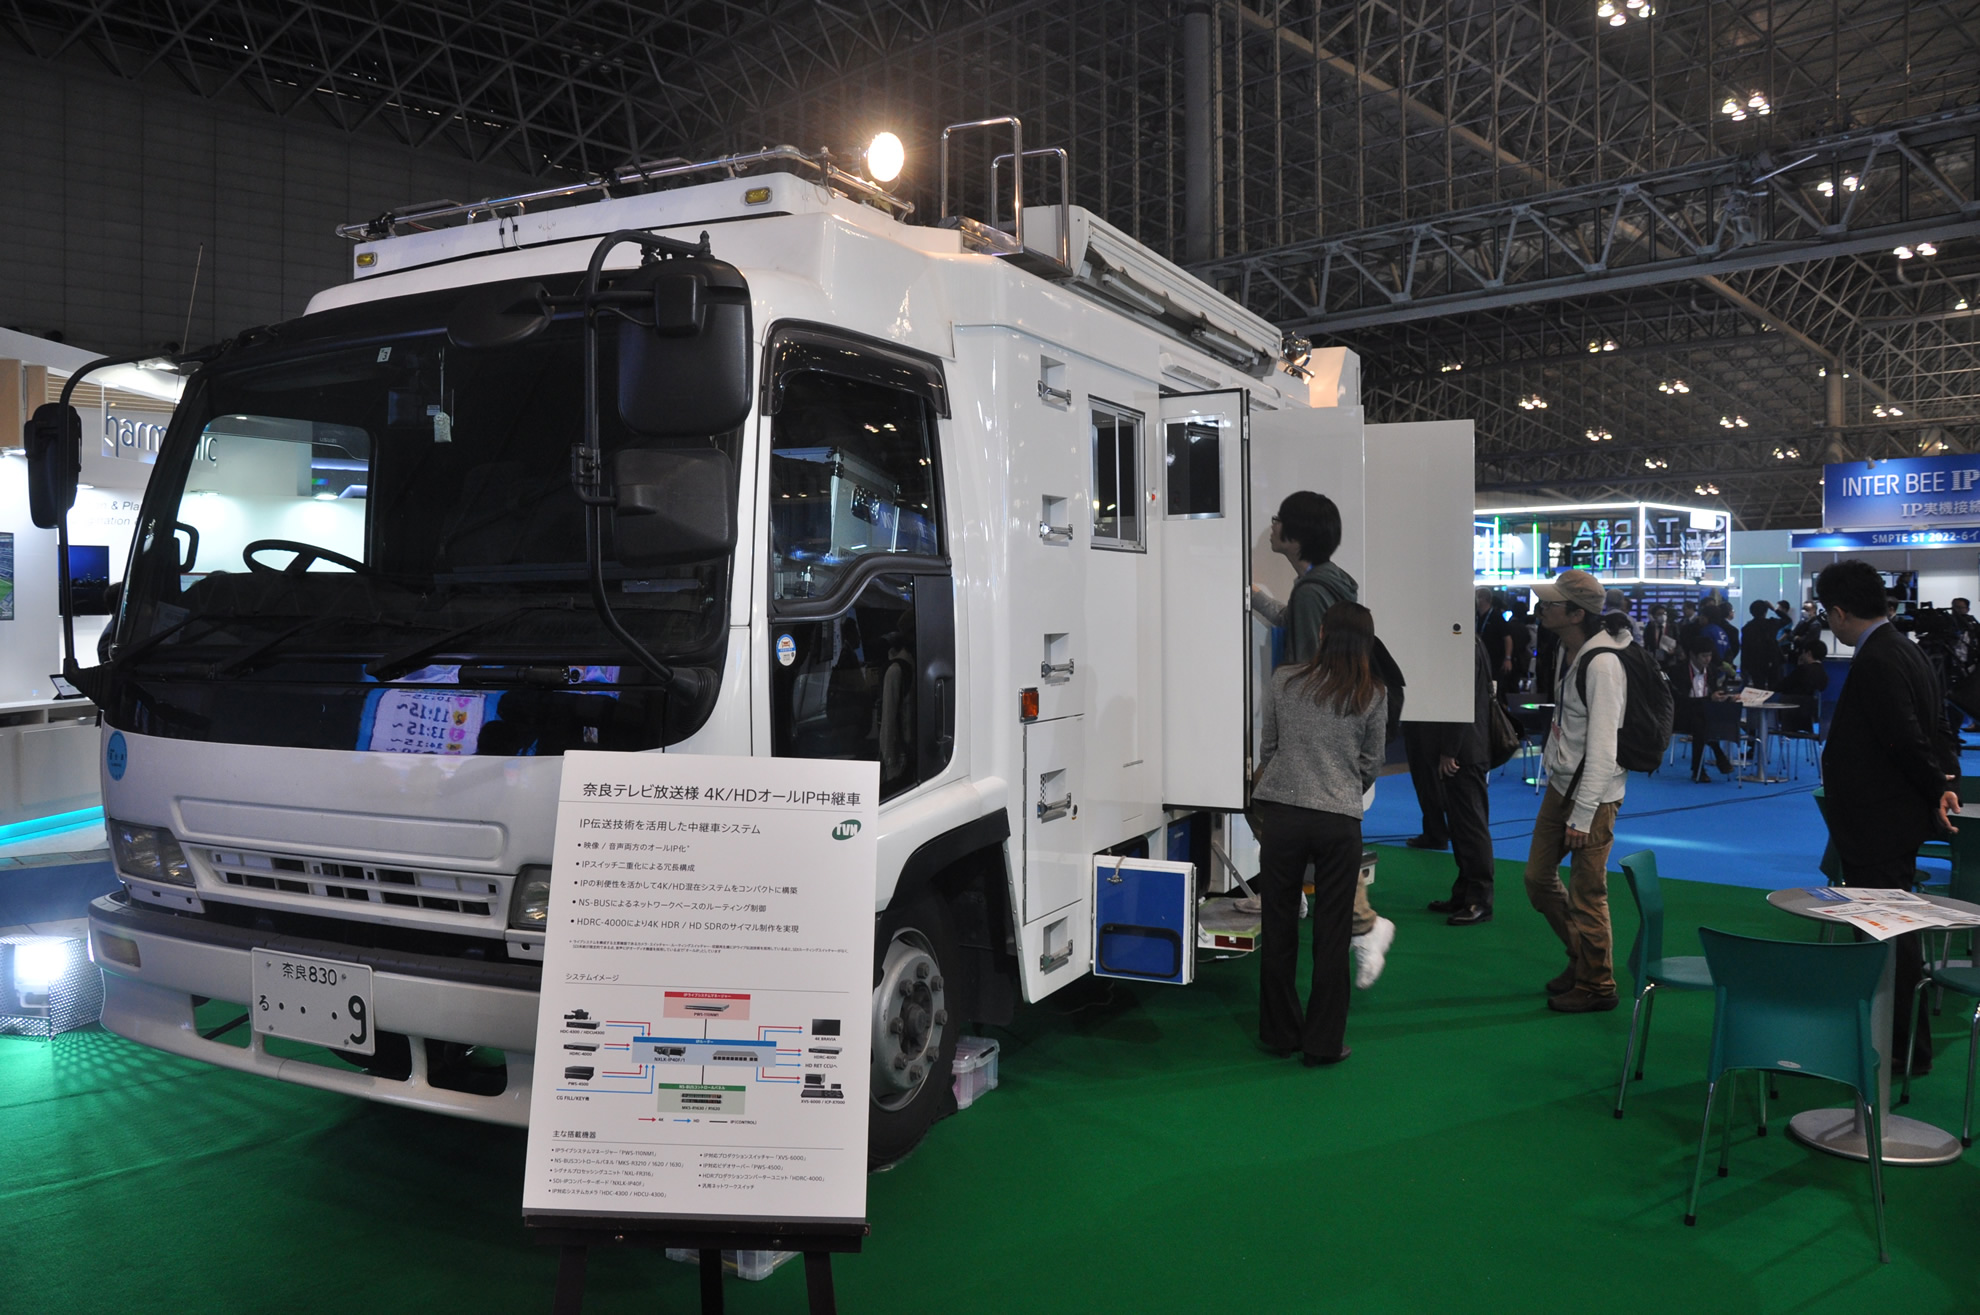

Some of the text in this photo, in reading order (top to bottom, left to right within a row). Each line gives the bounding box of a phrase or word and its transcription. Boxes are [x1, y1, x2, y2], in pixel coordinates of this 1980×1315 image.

[104, 401, 217, 462] harmic
[1842, 469, 1980, 497] INTER BEE IP
[111, 501, 118, 510] &
[1872, 533, 1907, 544] SMPTE
[1911, 533, 1925, 543] ST
[583, 782, 861, 806] 奈良テレビ放送様 4K/HDオールIP中継車
[579, 818, 761, 835] IP伝送技術を活用した中継車システム
[582, 861, 696, 872] IPスイッチ二重化による冗長構成
[580, 880, 798, 895] IPの利便性を活かして4K/HD混在システムをコンパクトに構築
[578, 899, 767, 912] NS-BUSによるネットワークベースのルーティング制御
[577, 918, 658, 928] HDRC-4000により4K
[661, 920, 680, 929] HDR
[689, 922, 702, 930] HD
[704, 922, 799, 933] SDRのサイマル制作を実現
[282, 962, 337, 986] 奈良830
[566, 973, 619, 982] システムイメージ
[553, 1130, 597, 1138] 主な搭載機器
